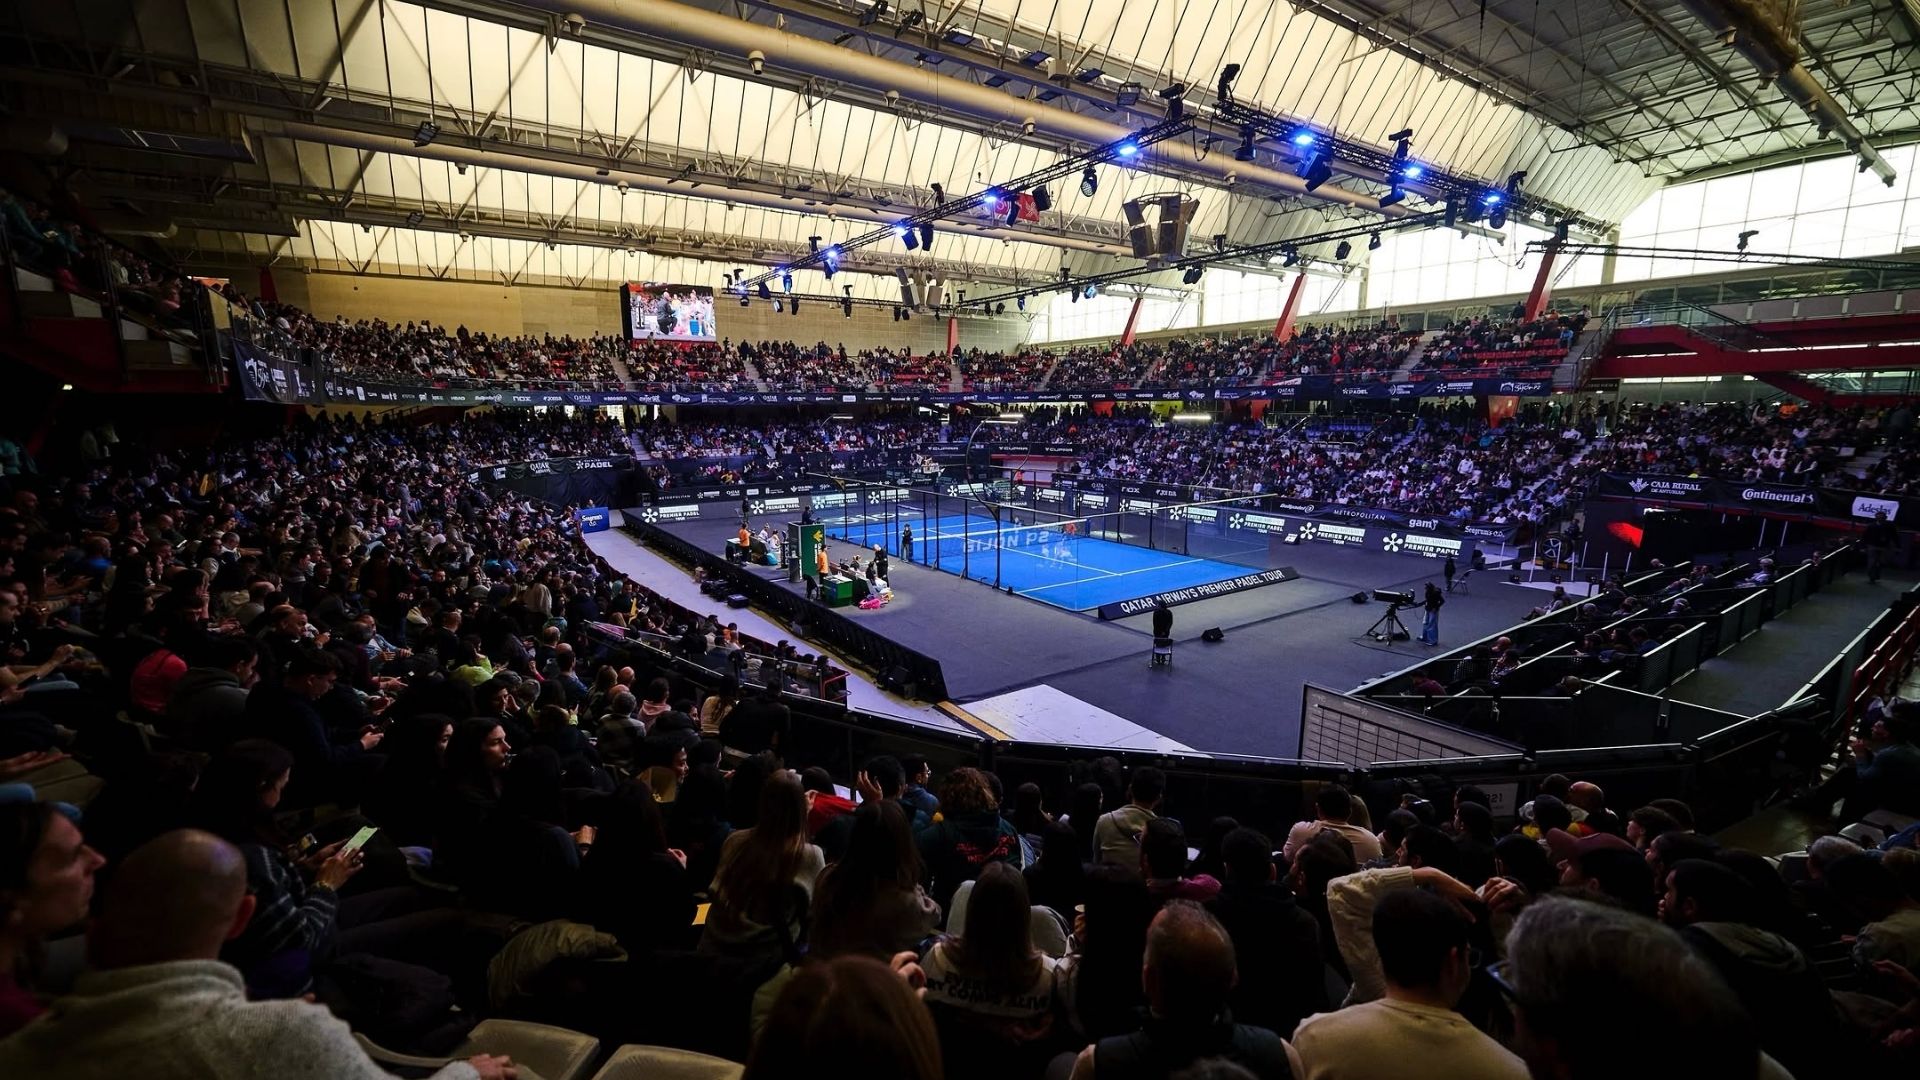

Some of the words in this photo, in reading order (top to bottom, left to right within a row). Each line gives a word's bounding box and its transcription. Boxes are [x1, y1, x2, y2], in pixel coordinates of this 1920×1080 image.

[1672, 482, 1701, 491] RURAL
[1741, 488, 1806, 504] Continental
[1333, 509, 1386, 520] METROPOLITAN
[1244, 521, 1266, 529] PREMIER
[1267, 524, 1284, 532] PADEL
[1317, 531, 1343, 540] PREMIER
[1344, 534, 1364, 543] PADEL
[1404, 543, 1434, 553] PREMIER
[1436, 547, 1460, 556] PADEL
[1120, 597, 1156, 613] QATAR
[1197, 580, 1235, 596] PREMIER
[1236, 575, 1264, 588] PADEL
[1262, 569, 1285, 582] TOUR
